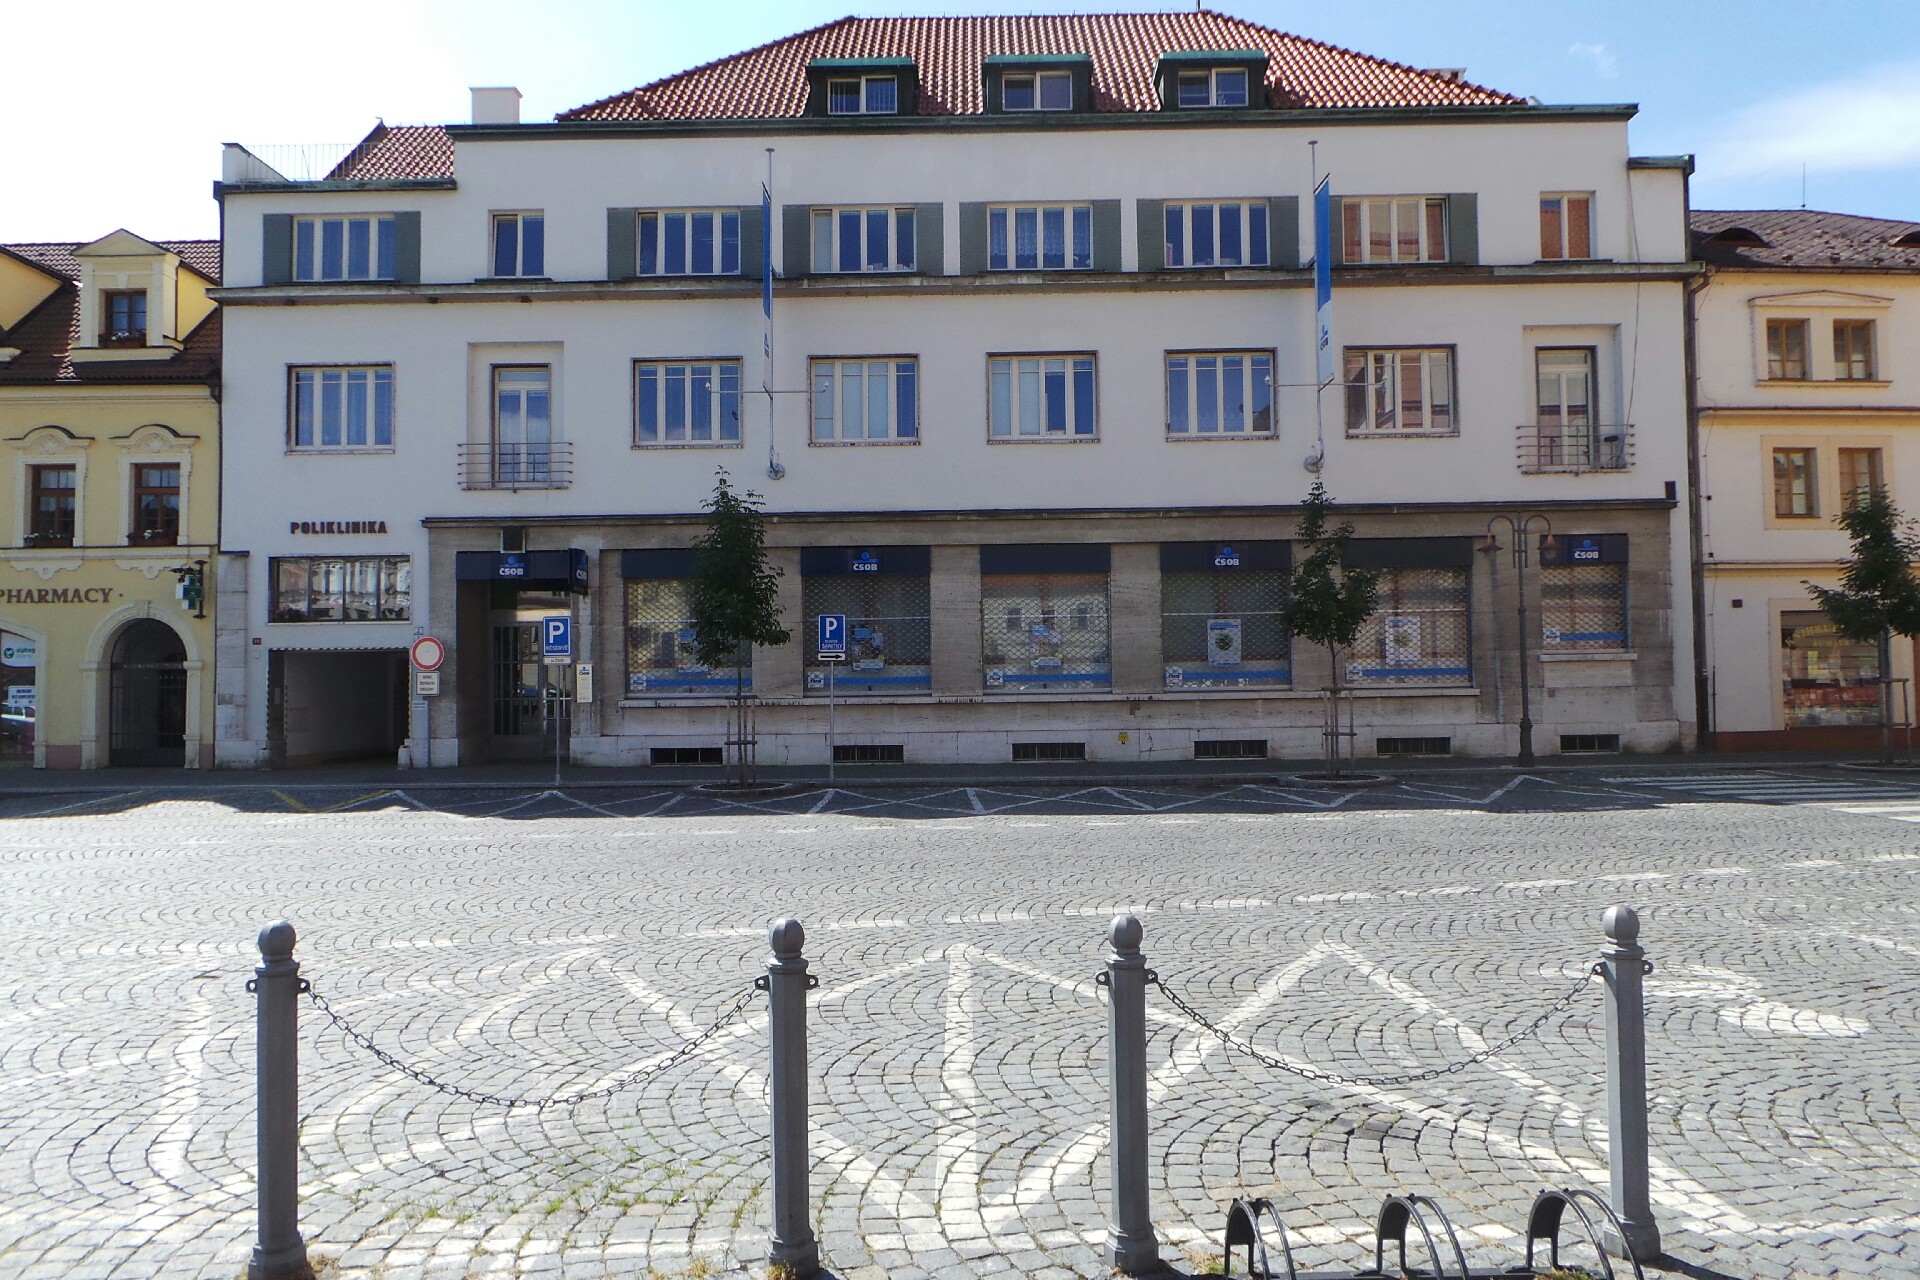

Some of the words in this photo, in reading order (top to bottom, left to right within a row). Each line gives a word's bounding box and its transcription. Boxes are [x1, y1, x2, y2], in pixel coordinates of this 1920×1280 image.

[290, 521, 387, 534] POLIKLINIKA
[549, 621, 565, 644] P
[825, 617, 838, 639] P
